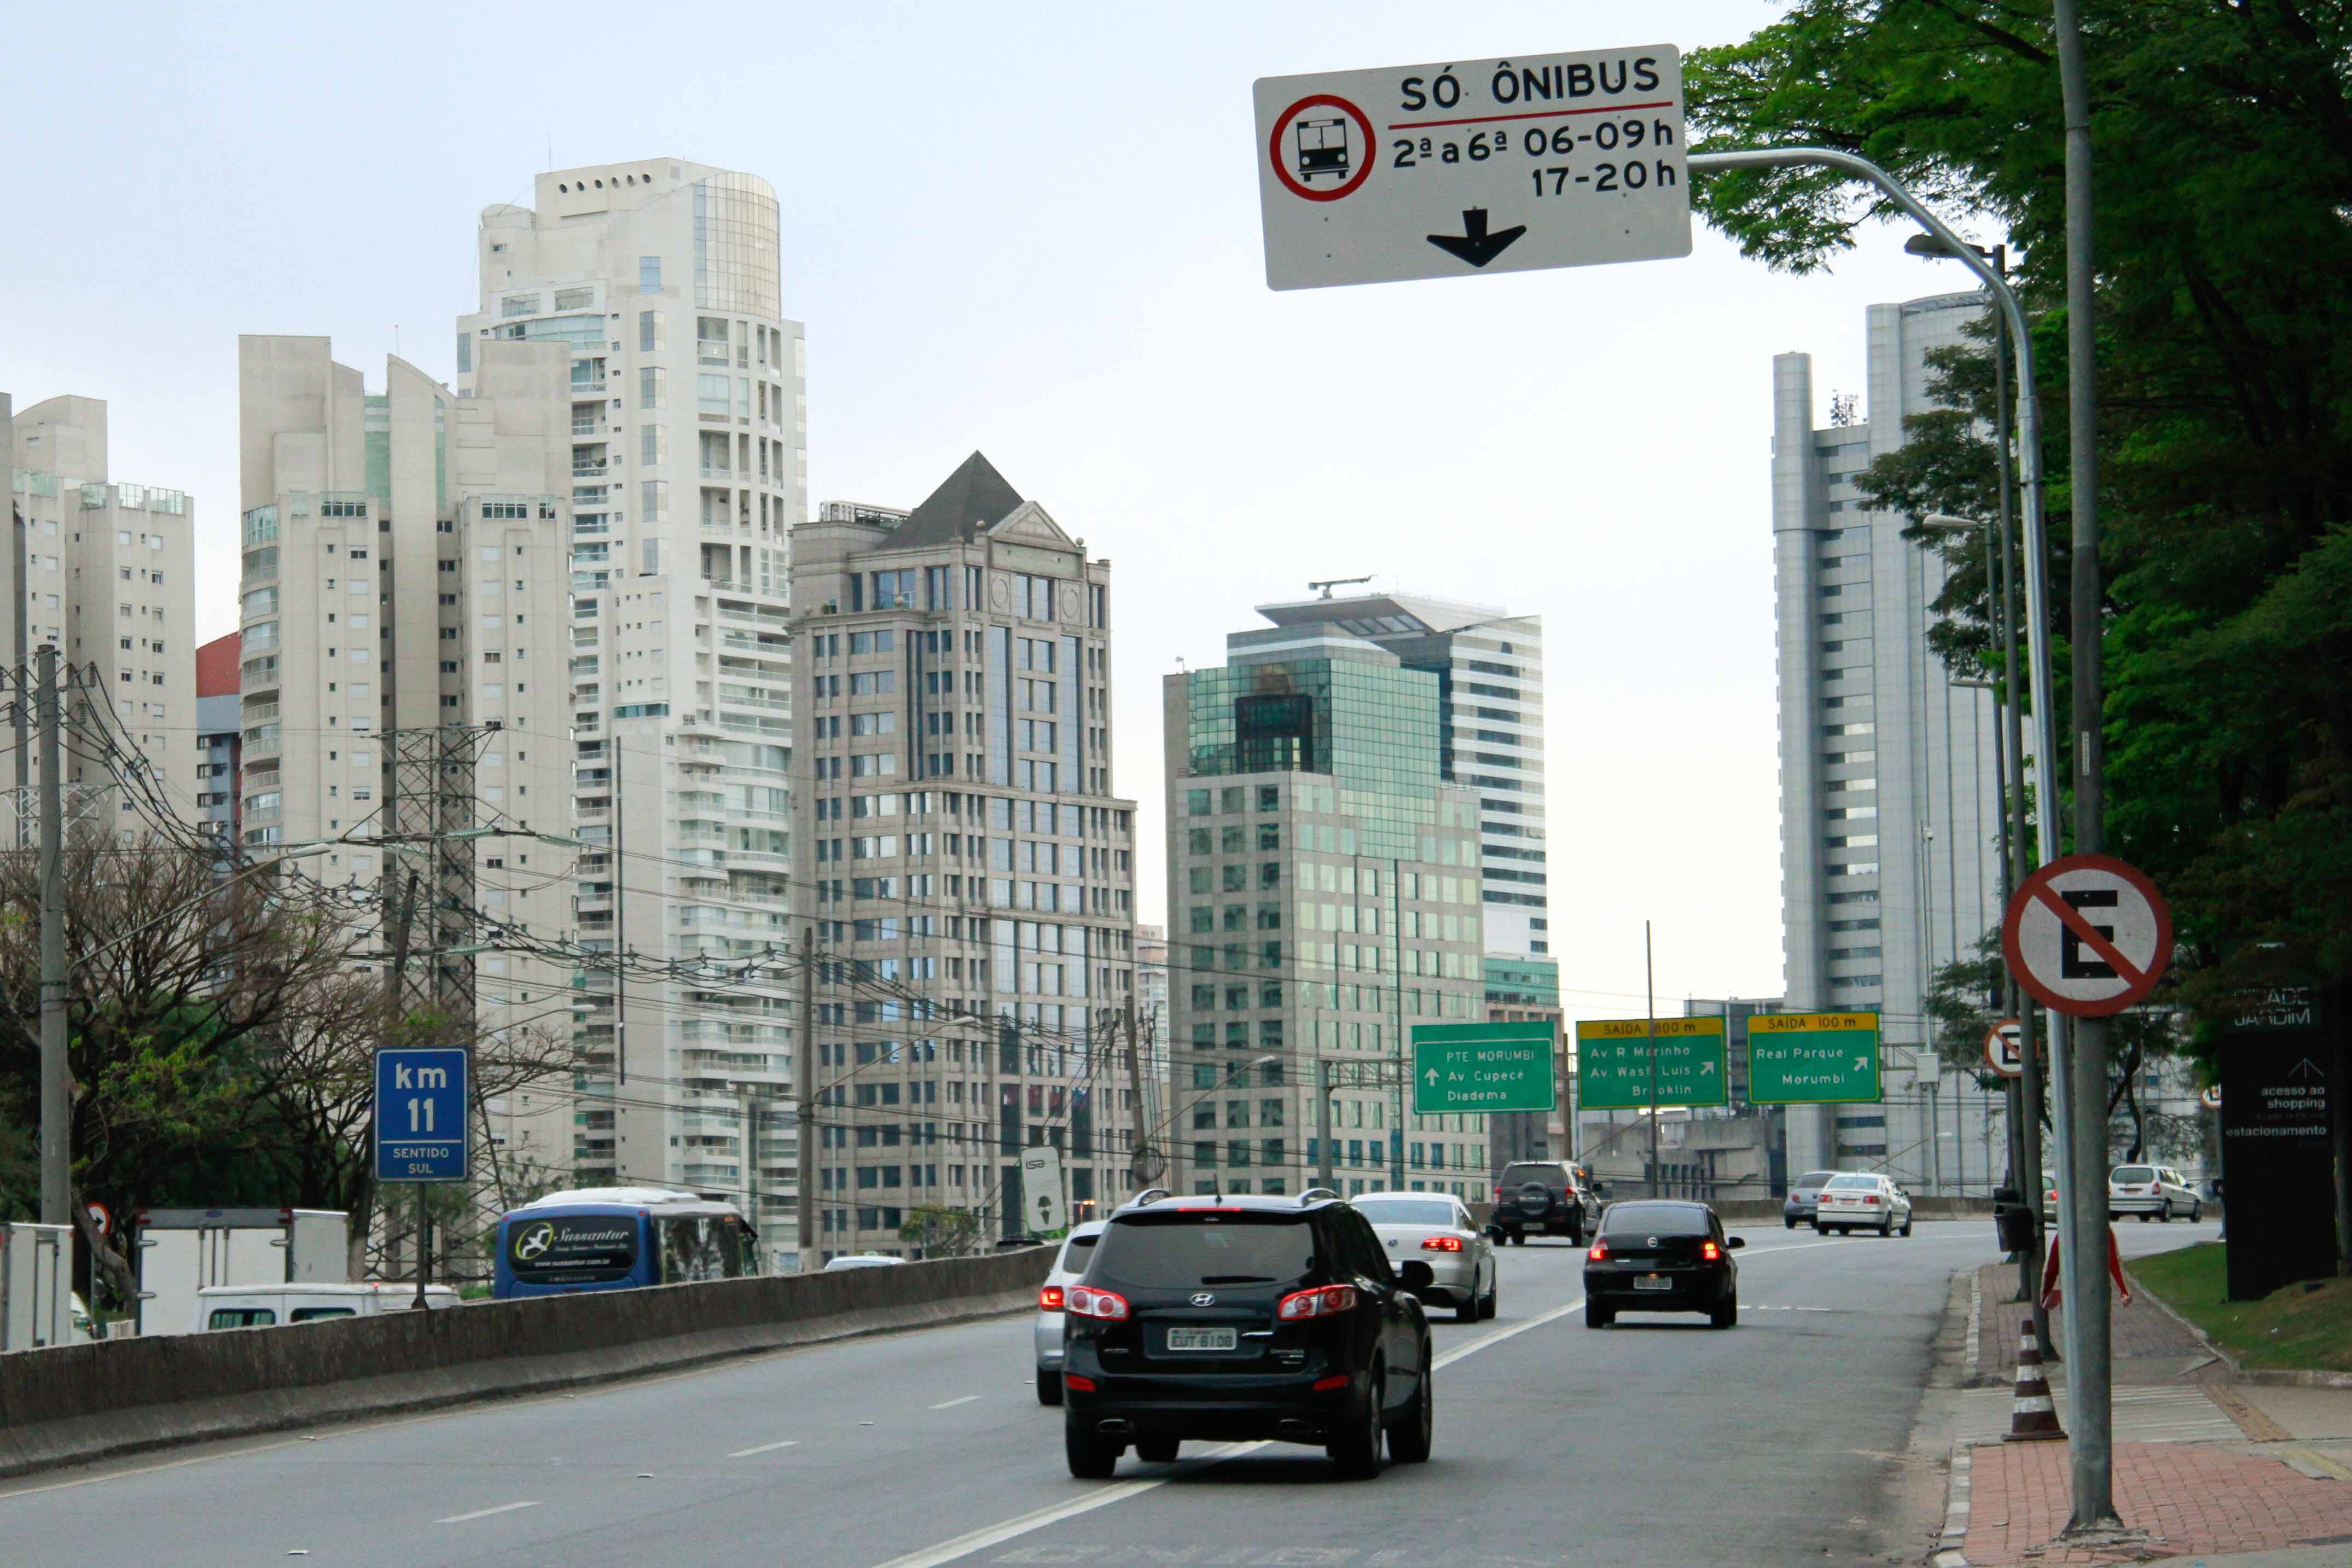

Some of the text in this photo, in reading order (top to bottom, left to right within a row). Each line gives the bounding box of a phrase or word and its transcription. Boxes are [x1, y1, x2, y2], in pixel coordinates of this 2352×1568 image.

[1401, 57, 1659, 111] SÓ ÔNIBUS
[2061, 890, 2118, 979] E
[1768, 1016, 1856, 1029] SAÍDA 100 m
[1604, 1023, 1696, 1035] SAÍDA 800 m
[1477, 1050, 1535, 1061] MORUMBI
[1756, 1048, 1844, 1060] Real Parque
[396, 1062, 446, 1089] km
[1474, 1070, 1524, 1083] Cupecé
[1782, 1073, 1844, 1085] Morumbi
[1448, 1090, 1507, 1101] Diadema
[1632, 1085, 1692, 1096] Broklin
[2261, 1087, 2325, 1096] acesso ao
[2267, 1098, 2325, 1110] shopping
[408, 1098, 434, 1132] 11
[2226, 1126, 2326, 1136] estacionamento
[393, 1148, 449, 1158] SENTIDO
[408, 1164, 433, 1174] SUL
